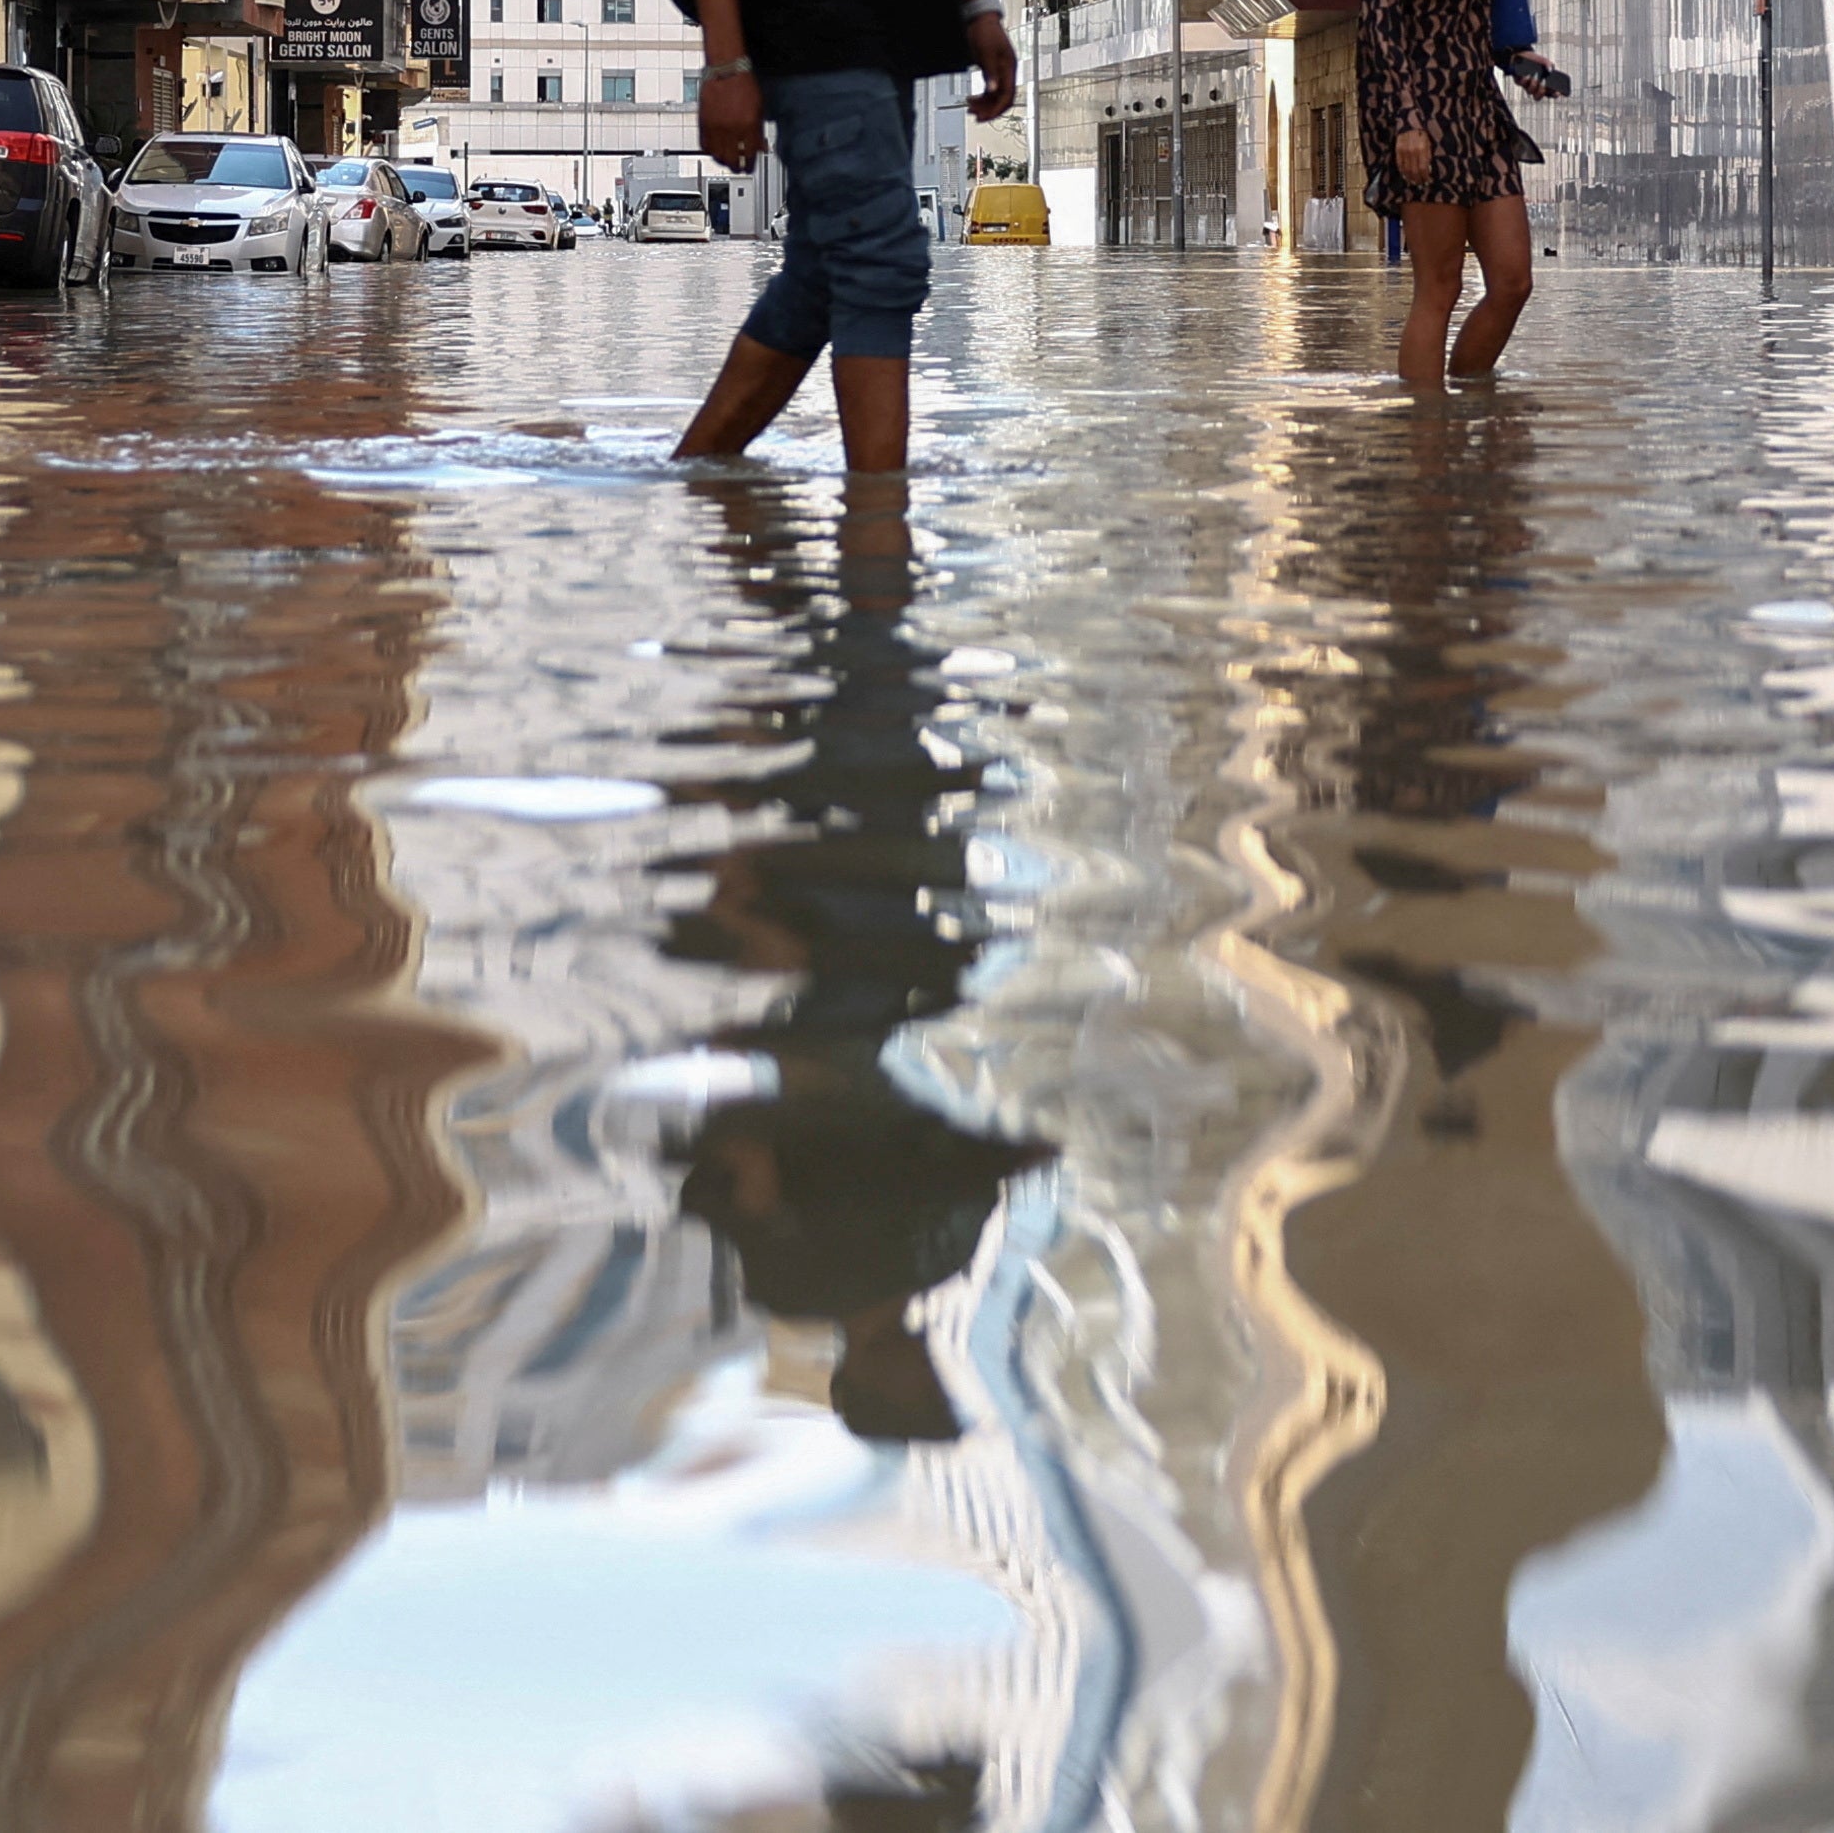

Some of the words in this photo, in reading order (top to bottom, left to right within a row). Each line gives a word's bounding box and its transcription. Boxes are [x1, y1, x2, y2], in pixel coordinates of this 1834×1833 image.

[348, 17, 374, 28] صالون
[288, 31, 327, 42] BRIGHT
[330, 31, 362, 42] MOON
[420, 28, 455, 39] GENTS
[279, 44, 324, 58] GENTS
[327, 44, 372, 58] SALON
[414, 41, 458, 56] SALON
